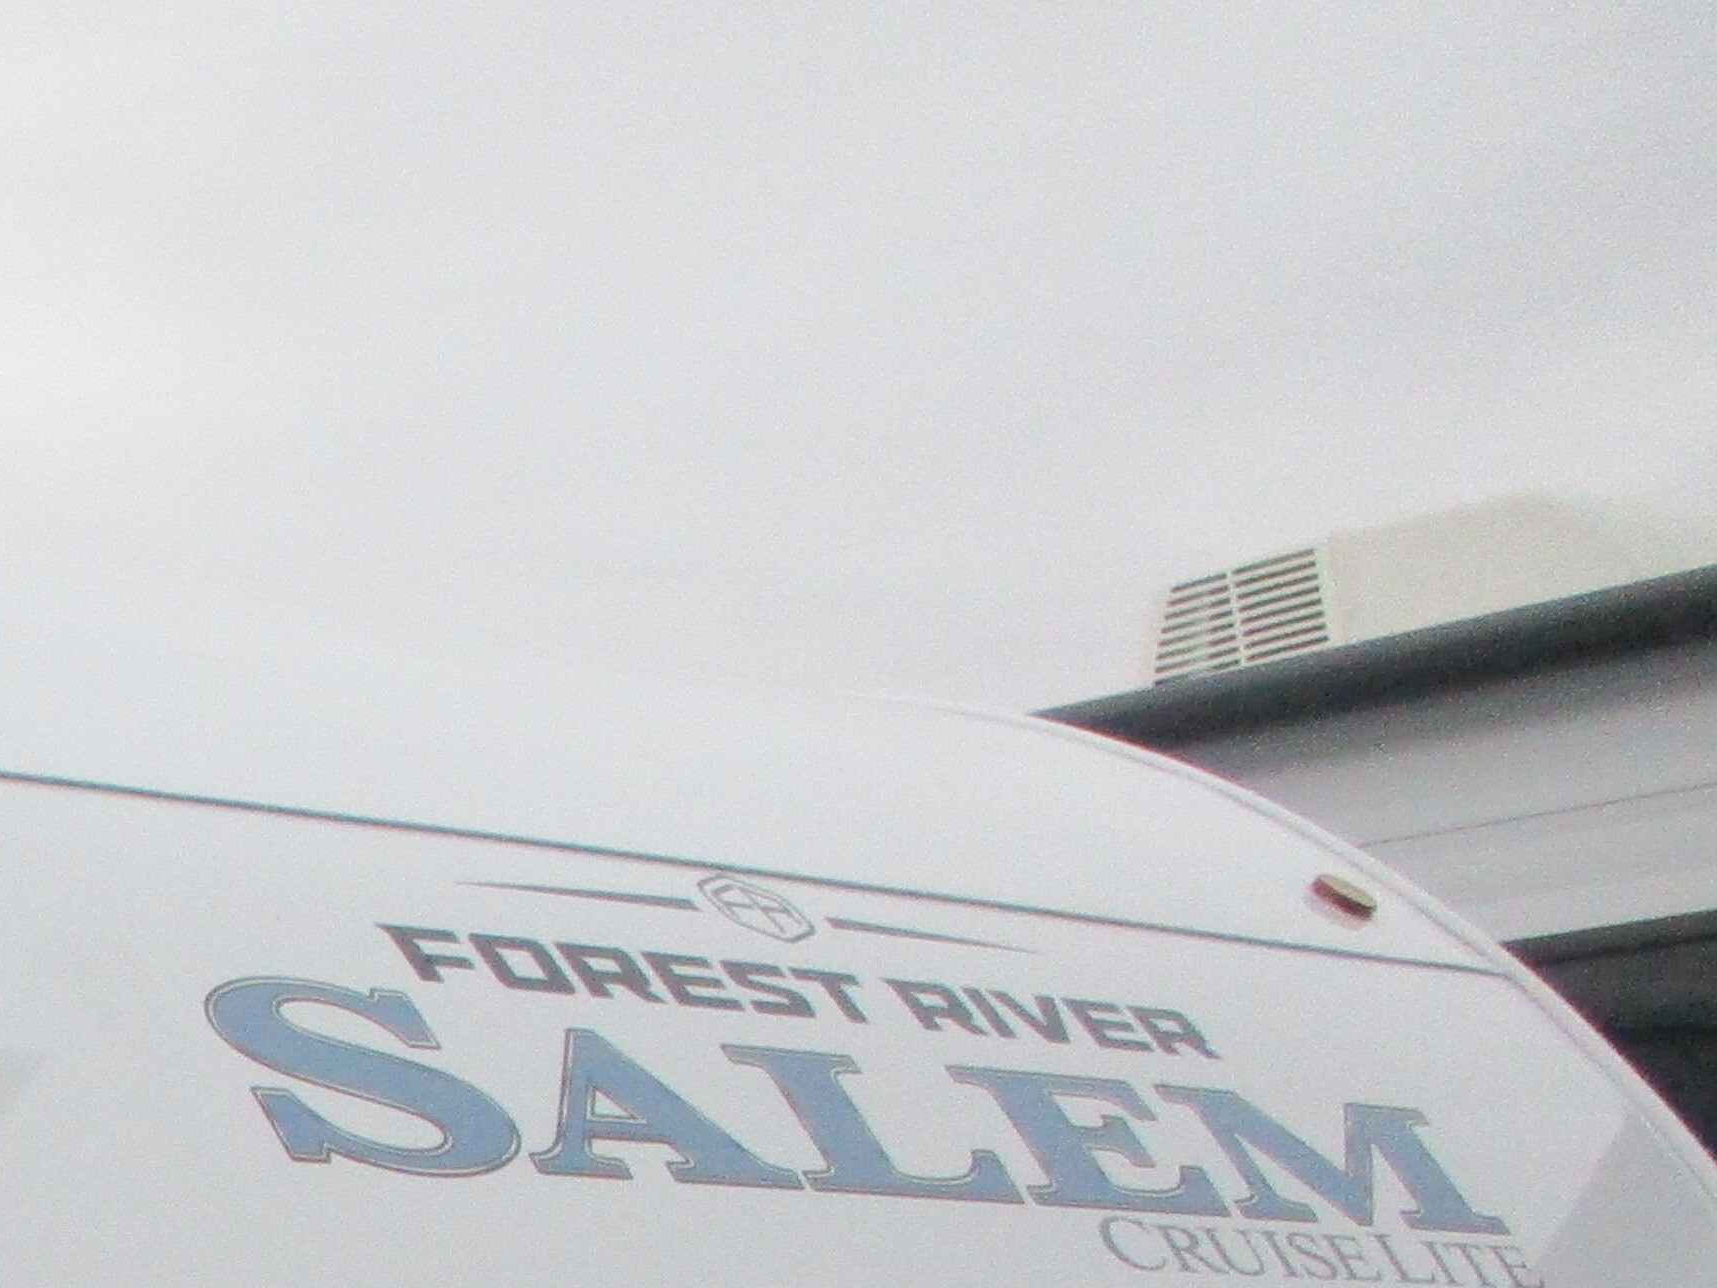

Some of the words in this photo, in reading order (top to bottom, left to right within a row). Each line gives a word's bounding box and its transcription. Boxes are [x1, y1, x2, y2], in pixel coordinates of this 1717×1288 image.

[375, 922, 870, 1024] FOREST
[880, 976, 1221, 1060] RIVER
[203, 974, 1511, 1236] SALEM
